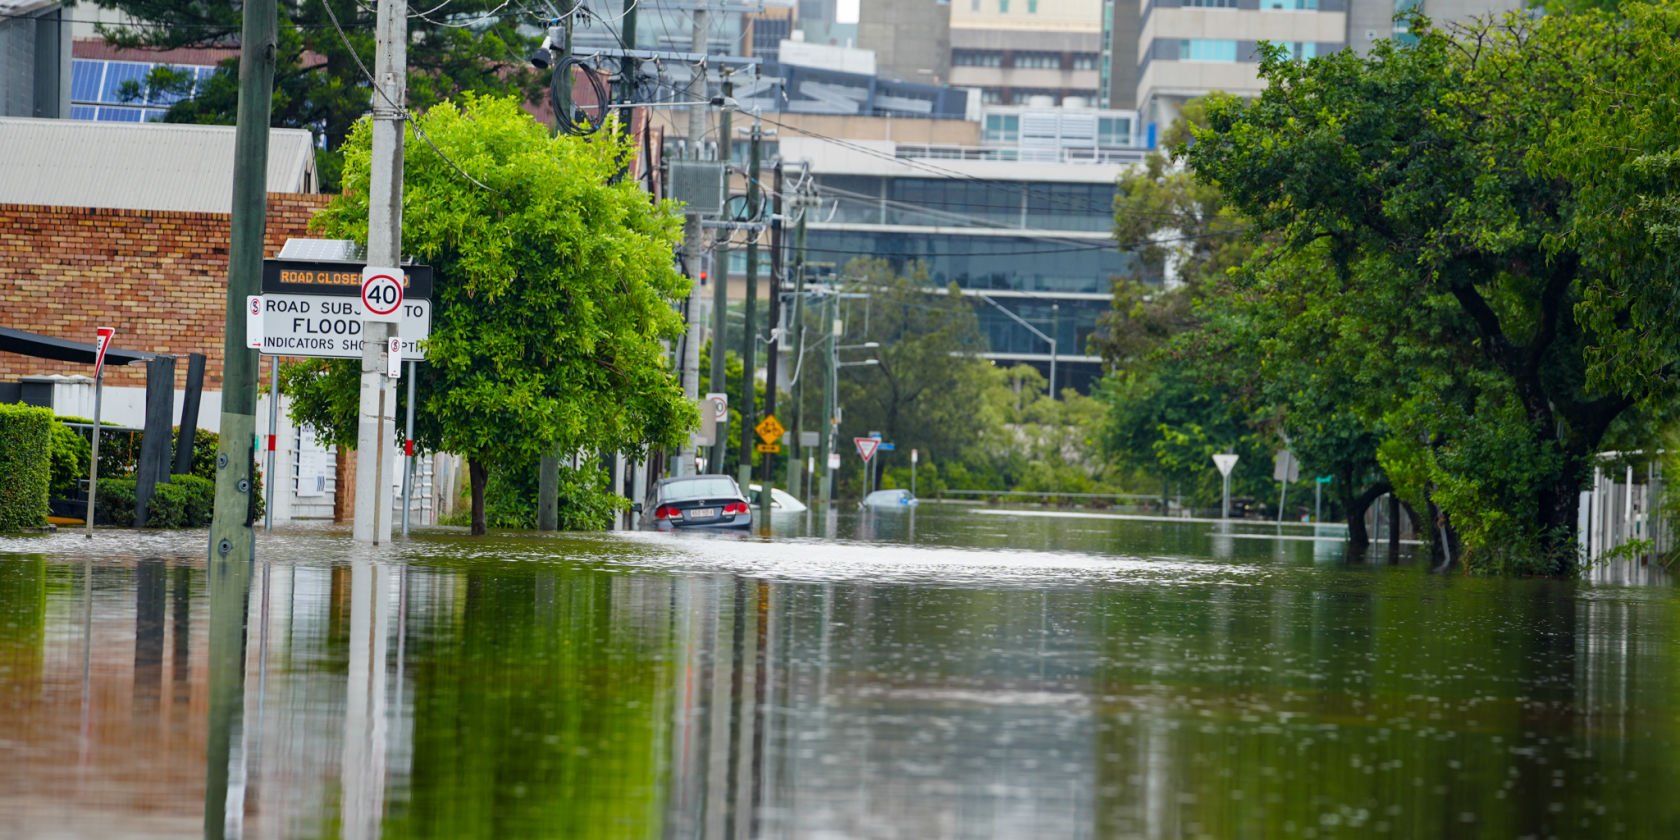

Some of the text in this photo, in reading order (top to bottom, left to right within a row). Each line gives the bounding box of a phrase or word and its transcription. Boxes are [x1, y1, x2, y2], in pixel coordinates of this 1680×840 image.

[281, 271, 313, 284] ROAD
[367, 285, 397, 304] 40
[266, 300, 310, 313] ROAD
[404, 305, 423, 318] TO
[293, 317, 361, 335] FLOOD
[264, 336, 334, 350] INDICATORS
